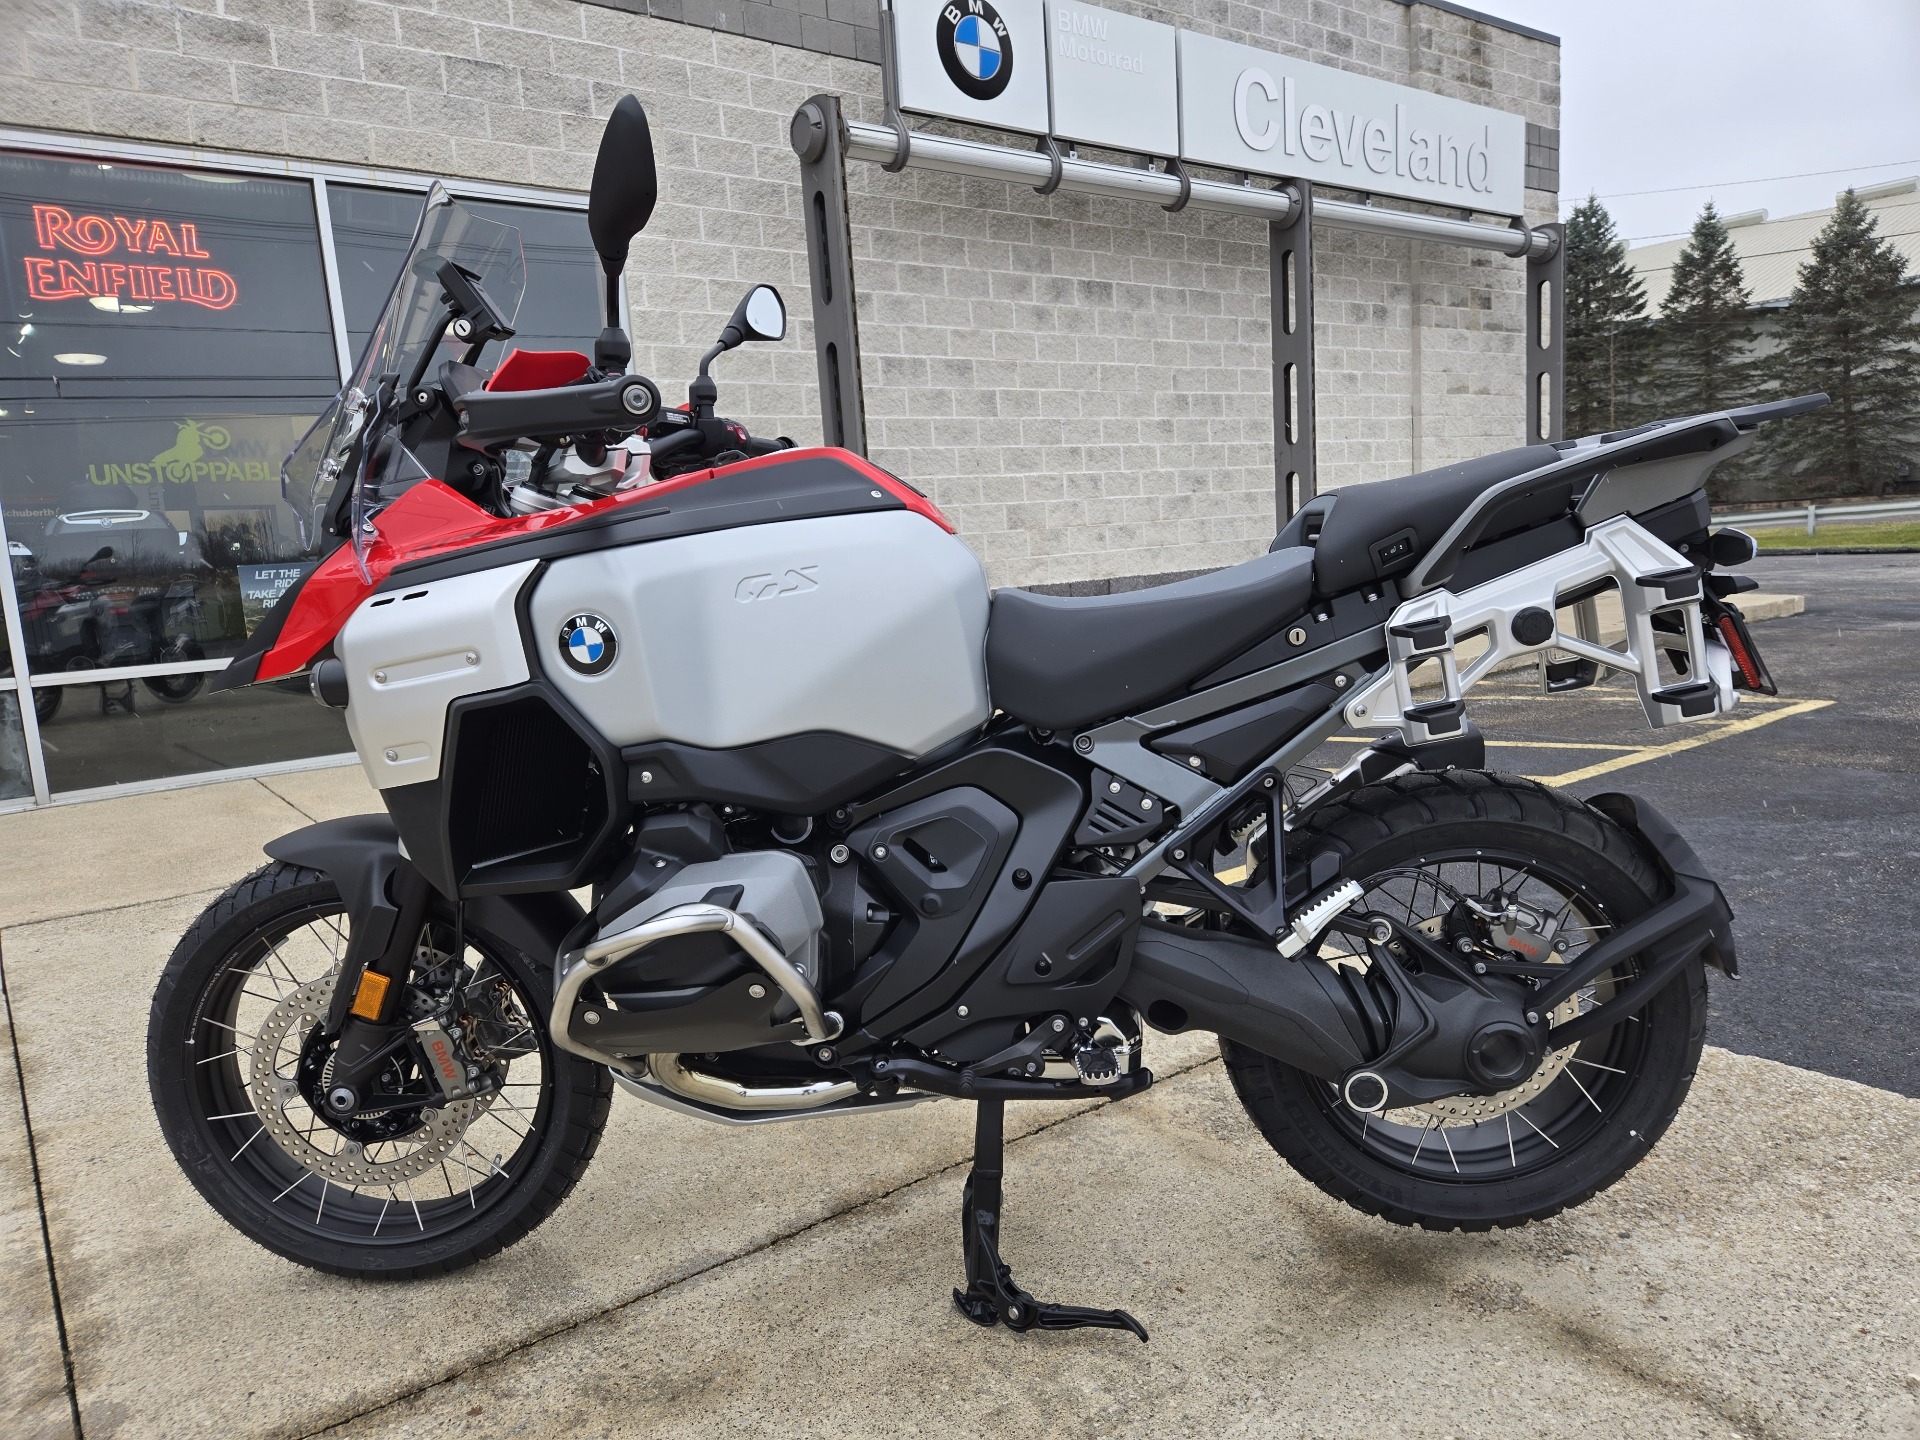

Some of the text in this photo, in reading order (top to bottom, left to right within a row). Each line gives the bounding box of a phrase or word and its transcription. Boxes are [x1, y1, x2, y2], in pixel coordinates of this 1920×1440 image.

[944, 0, 1007, 37] BMW
[1057, 8, 1107, 41] BMW
[1059, 34, 1143, 75] Motorrad
[1233, 67, 1493, 194] Cleveland
[32, 205, 210, 259] ROYAL
[24, 257, 238, 310] ENFIELD
[255, 569, 300, 579] LET THE
[274, 578, 298, 588] RID
[734, 565, 819, 603] GS
[247, 590, 277, 599] TAKE
[262, 599, 279, 608] RI
[562, 616, 608, 639] BMW
[1507, 936, 1540, 957] BMW
[431, 1039, 458, 1081] BMW
